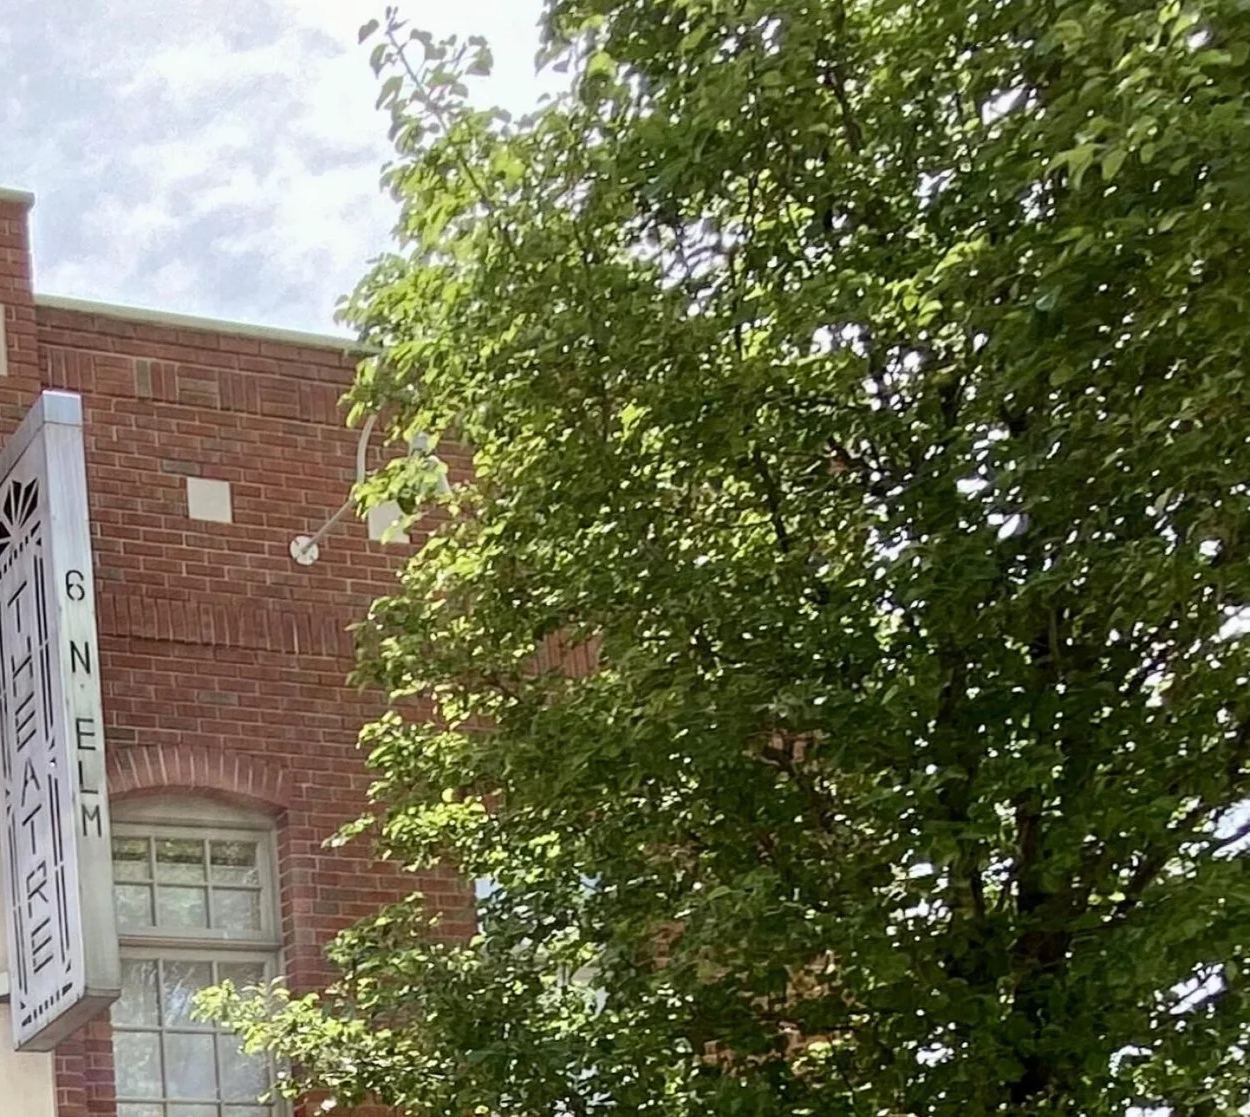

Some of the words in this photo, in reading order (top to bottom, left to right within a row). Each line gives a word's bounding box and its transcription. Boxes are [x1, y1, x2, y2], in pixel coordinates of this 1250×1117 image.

[7, 580, 54, 975] THEATRE
[64, 569, 86, 603] 6
[75, 717, 102, 838] ELM
